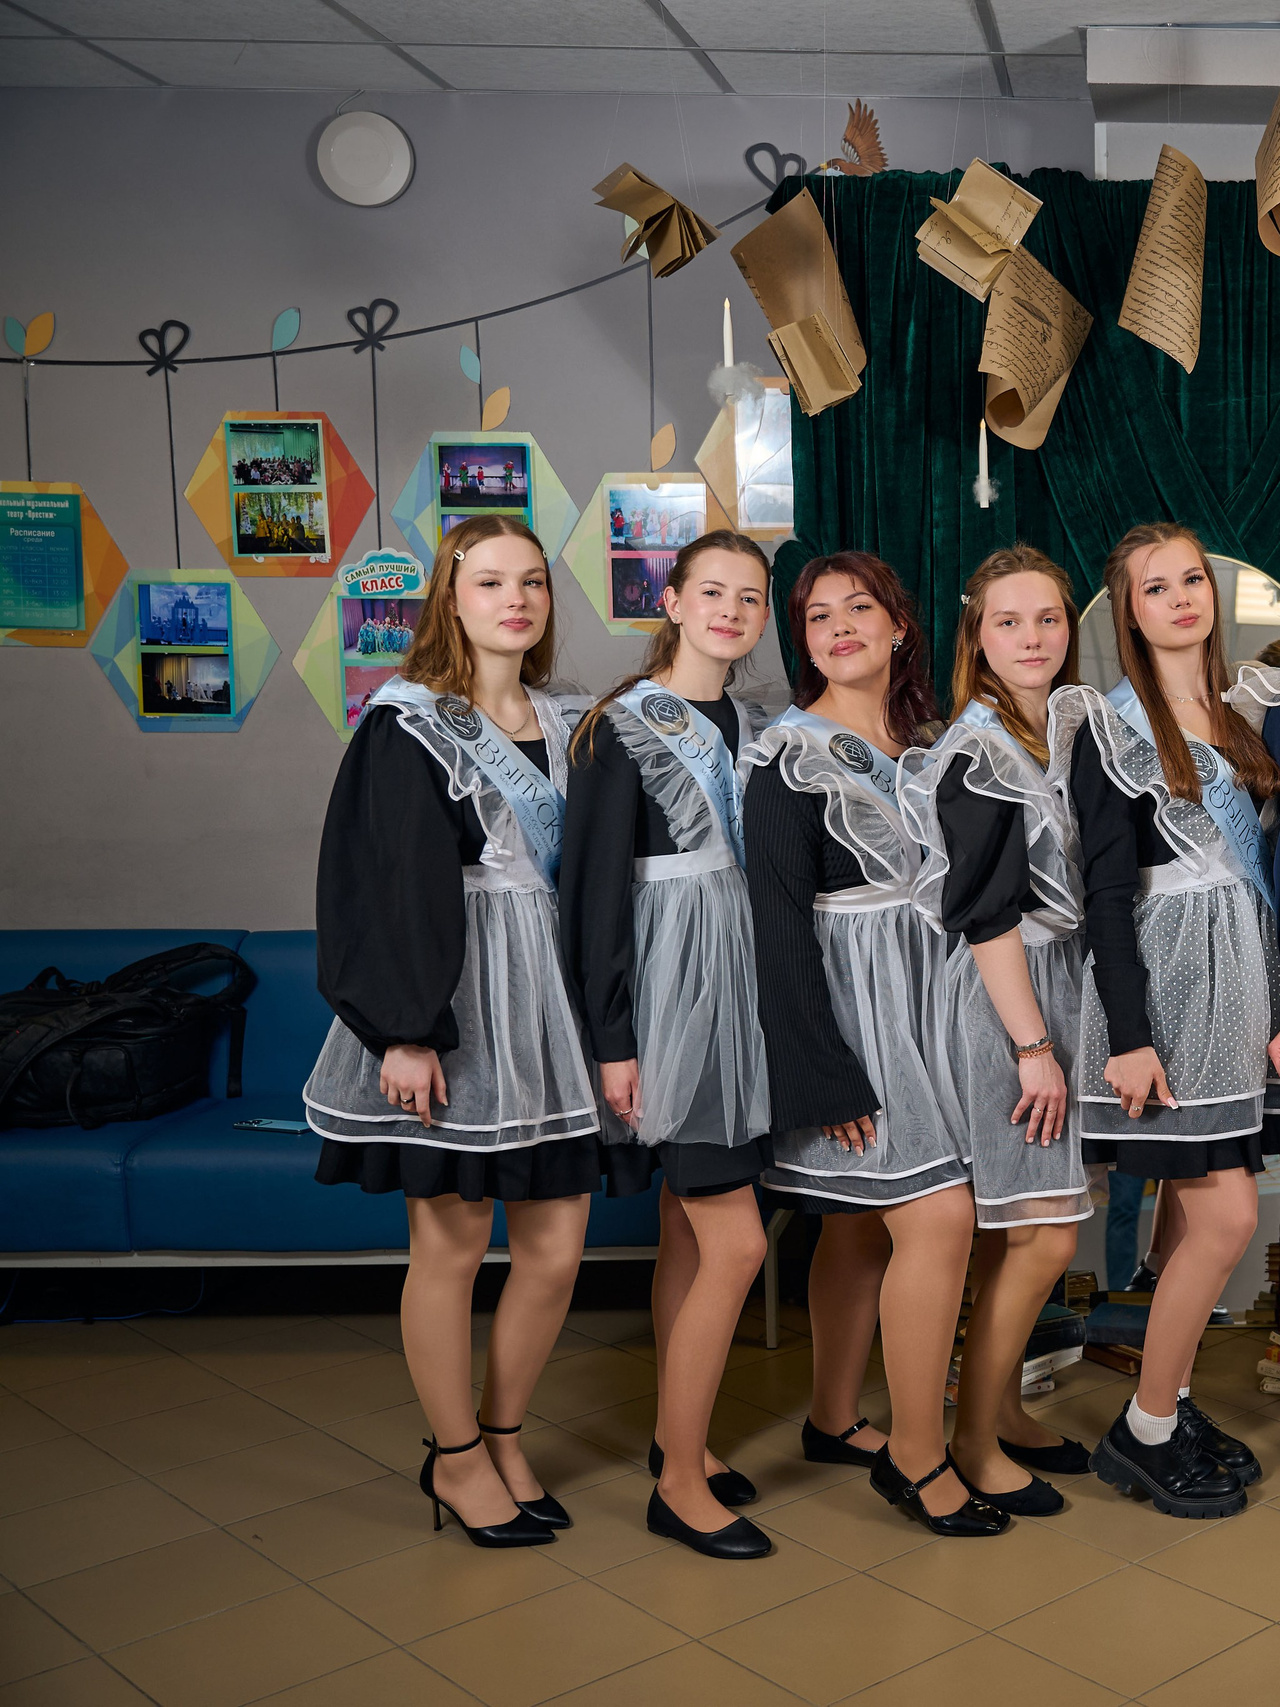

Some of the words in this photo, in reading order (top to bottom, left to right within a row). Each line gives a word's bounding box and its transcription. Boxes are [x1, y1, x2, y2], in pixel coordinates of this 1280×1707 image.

[10, 528, 56, 537] Расписание
[345, 564, 376, 583] САМЫЙ
[378, 565, 416, 574] ЛУЧШИЙ
[361, 576, 404, 593] КЛАСС
